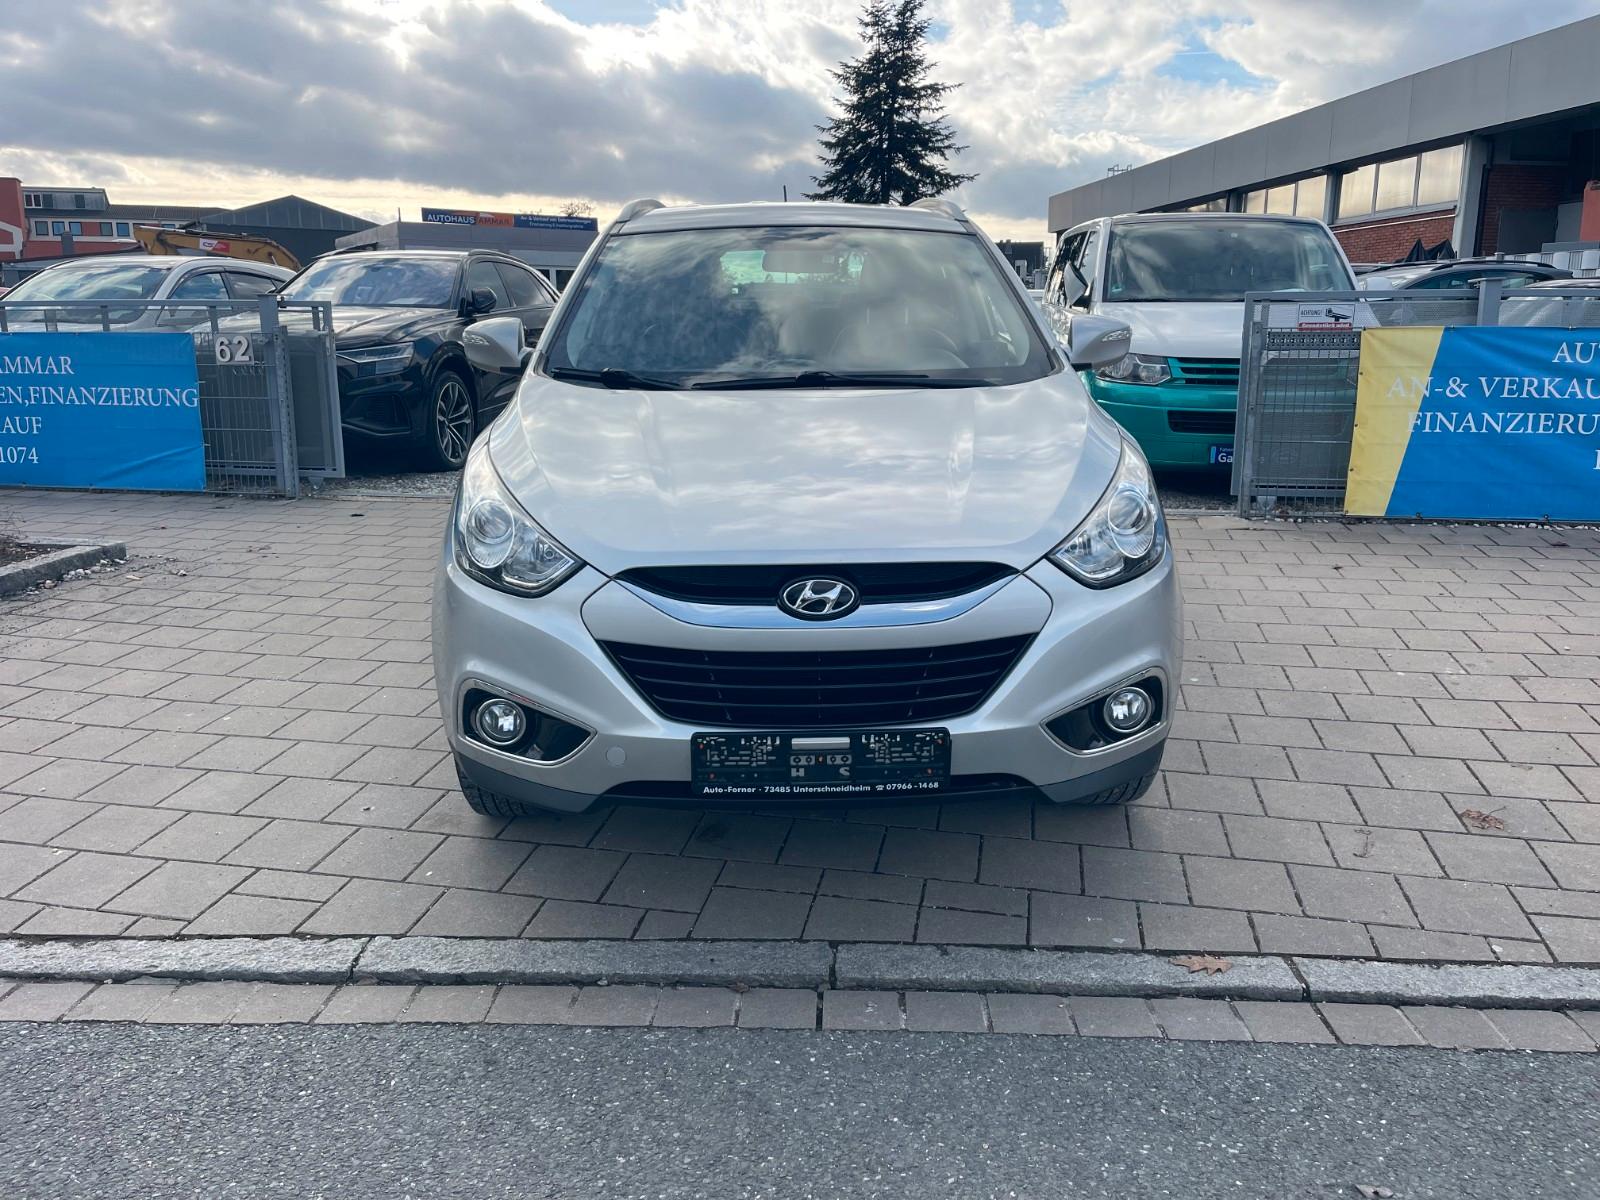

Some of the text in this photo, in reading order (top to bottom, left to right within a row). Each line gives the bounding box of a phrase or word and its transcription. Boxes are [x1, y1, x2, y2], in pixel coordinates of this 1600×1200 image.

[427, 213, 475, 224] AUTOHAUS
[215, 335, 251, 363] 62
[1551, 341, 1600, 364] AU
[0, 415, 42, 435] AUF
[1407, 411, 1600, 435] FINANZIERU
[793, 784, 871, 793] Unterschneidheim
